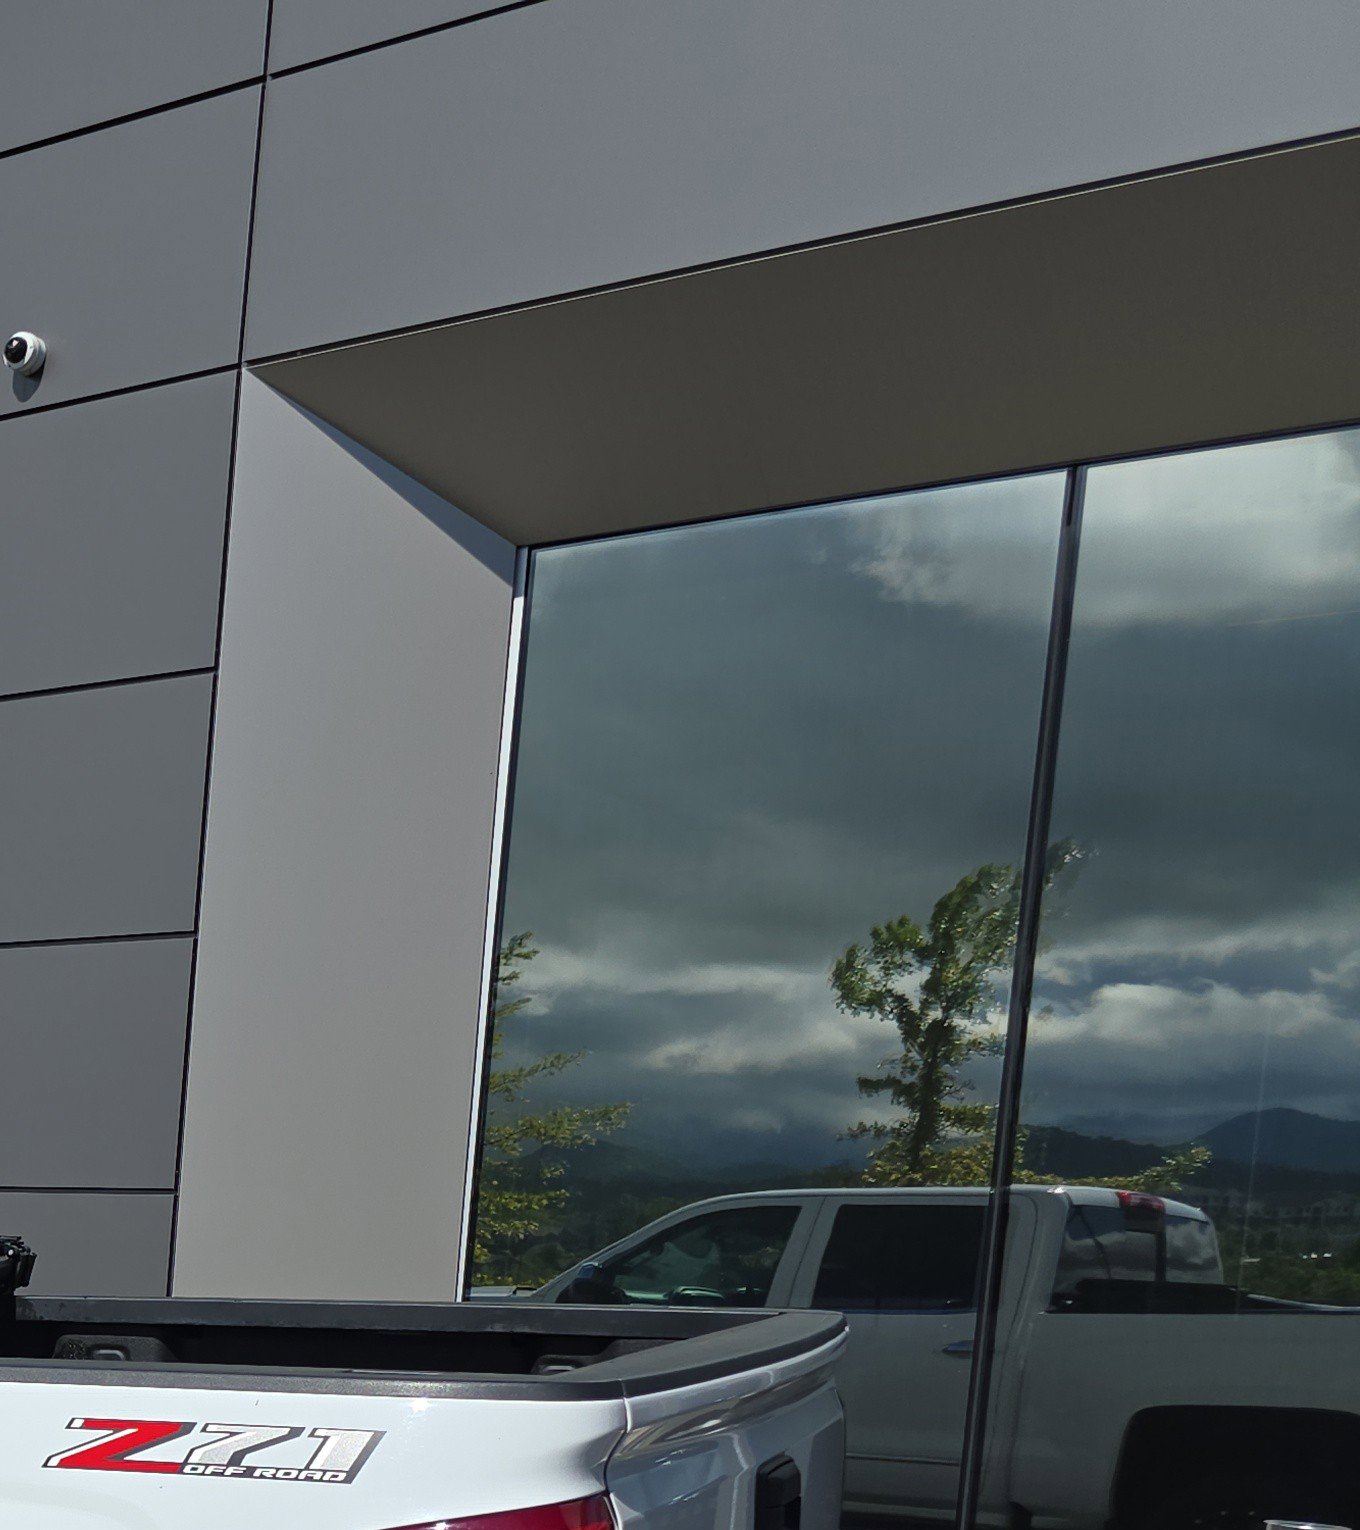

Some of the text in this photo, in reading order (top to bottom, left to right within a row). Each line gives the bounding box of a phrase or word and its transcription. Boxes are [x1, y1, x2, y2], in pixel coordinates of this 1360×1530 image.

[41, 1416, 387, 1476] Z71
[183, 1463, 348, 1482] OFF ROAD
